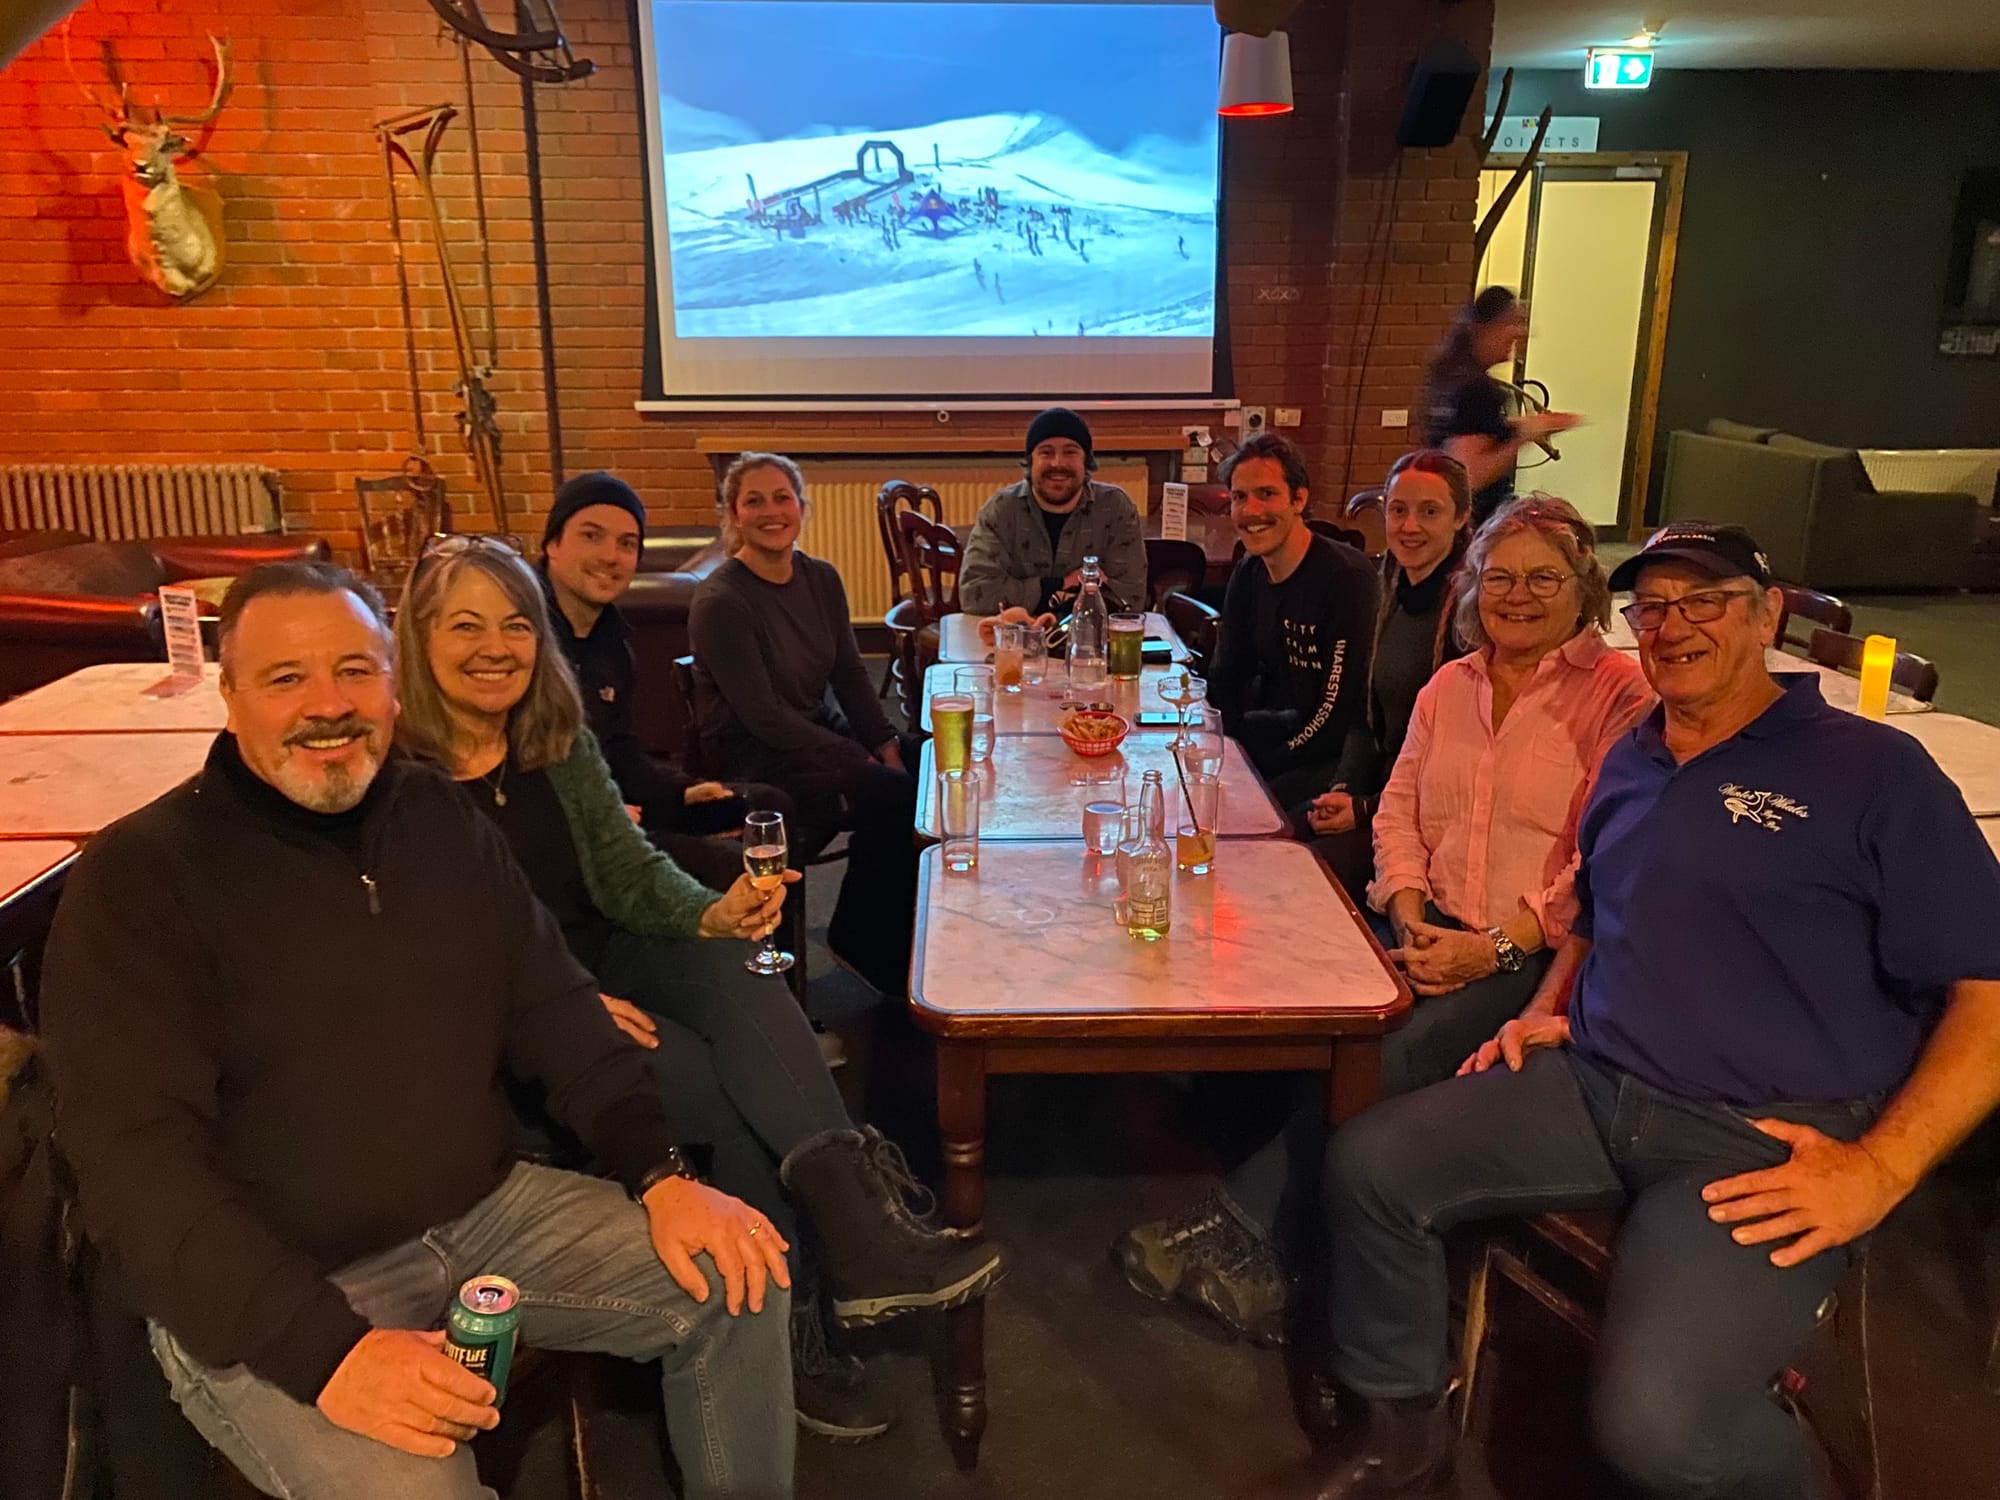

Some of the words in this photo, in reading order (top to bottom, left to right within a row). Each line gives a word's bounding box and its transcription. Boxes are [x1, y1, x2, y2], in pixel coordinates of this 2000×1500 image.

[1503, 136, 1580, 148] OIETS
[1283, 618, 1318, 636] CITY
[1286, 636, 1319, 656] CALM
